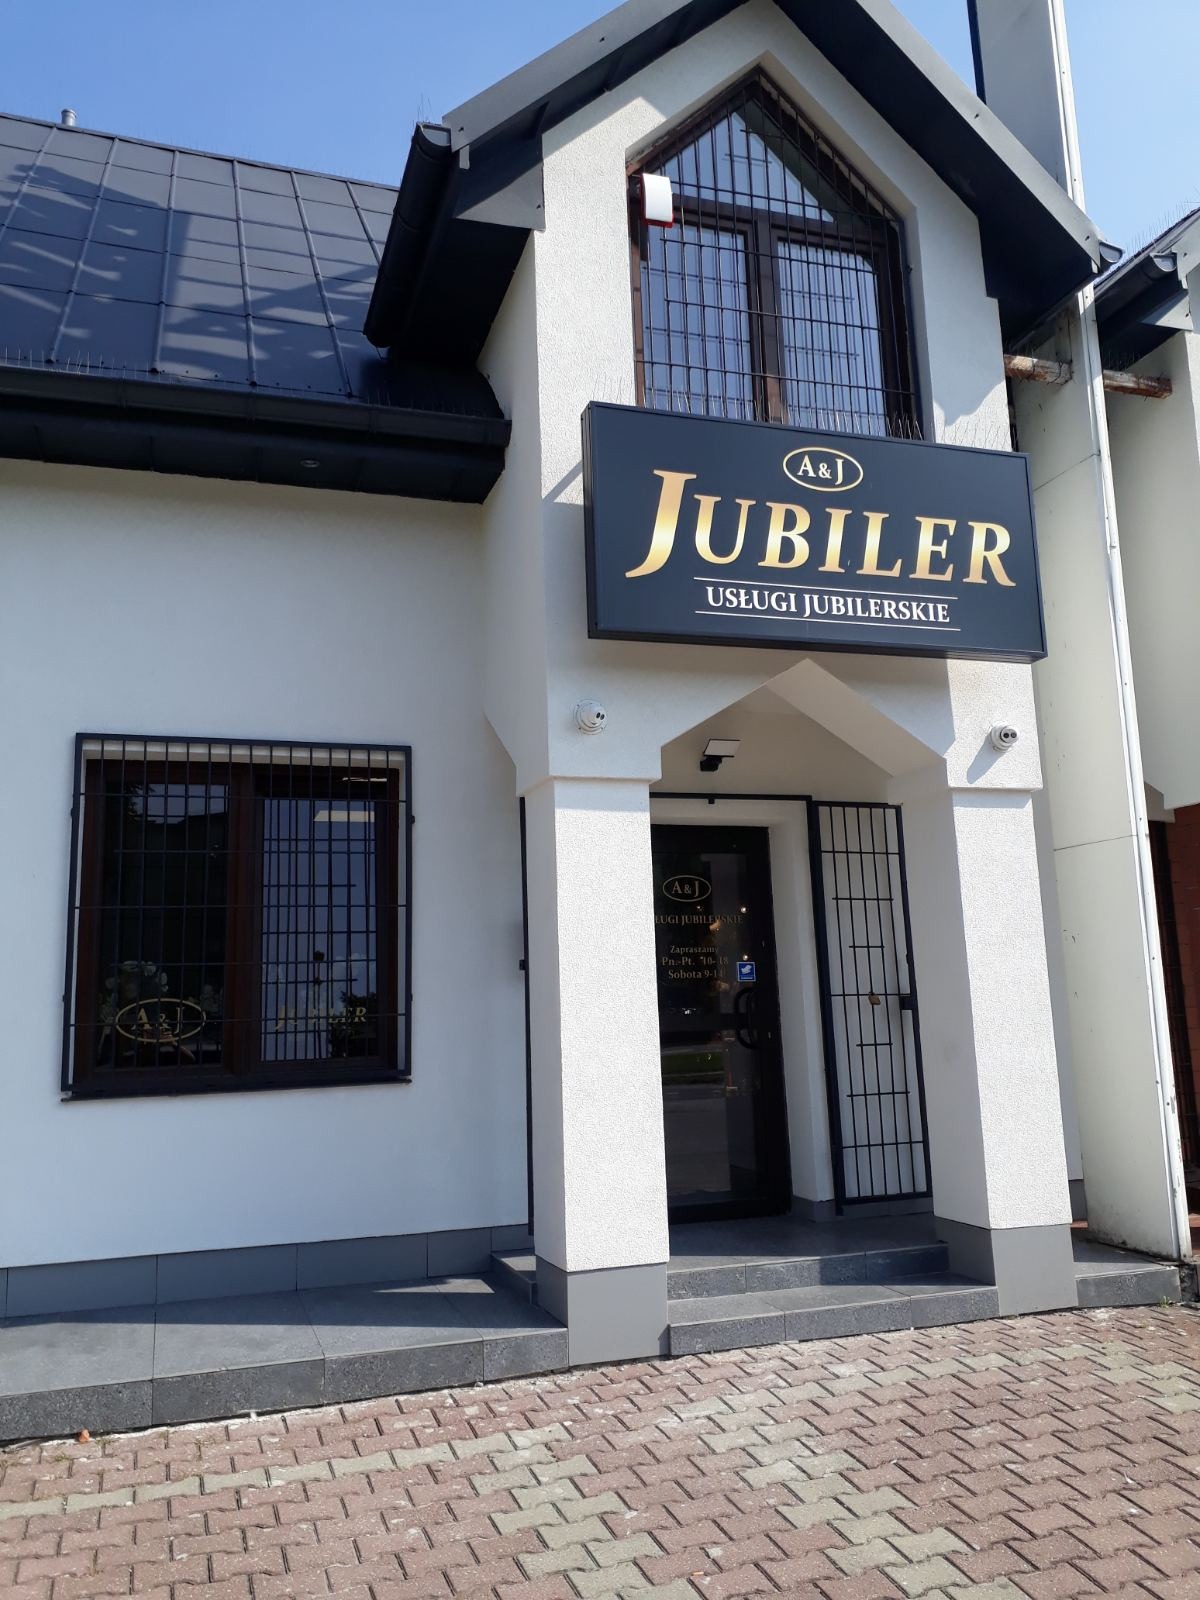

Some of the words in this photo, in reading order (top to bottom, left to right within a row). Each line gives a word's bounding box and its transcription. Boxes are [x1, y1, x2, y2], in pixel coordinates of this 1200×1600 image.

[797, 454, 845, 486] A&J
[625, 469, 1017, 587] JUBILER
[706, 586, 798, 613] USŁUGI
[802, 594, 951, 623] JUBILERSKIE
[668, 969, 702, 979] Sobota
